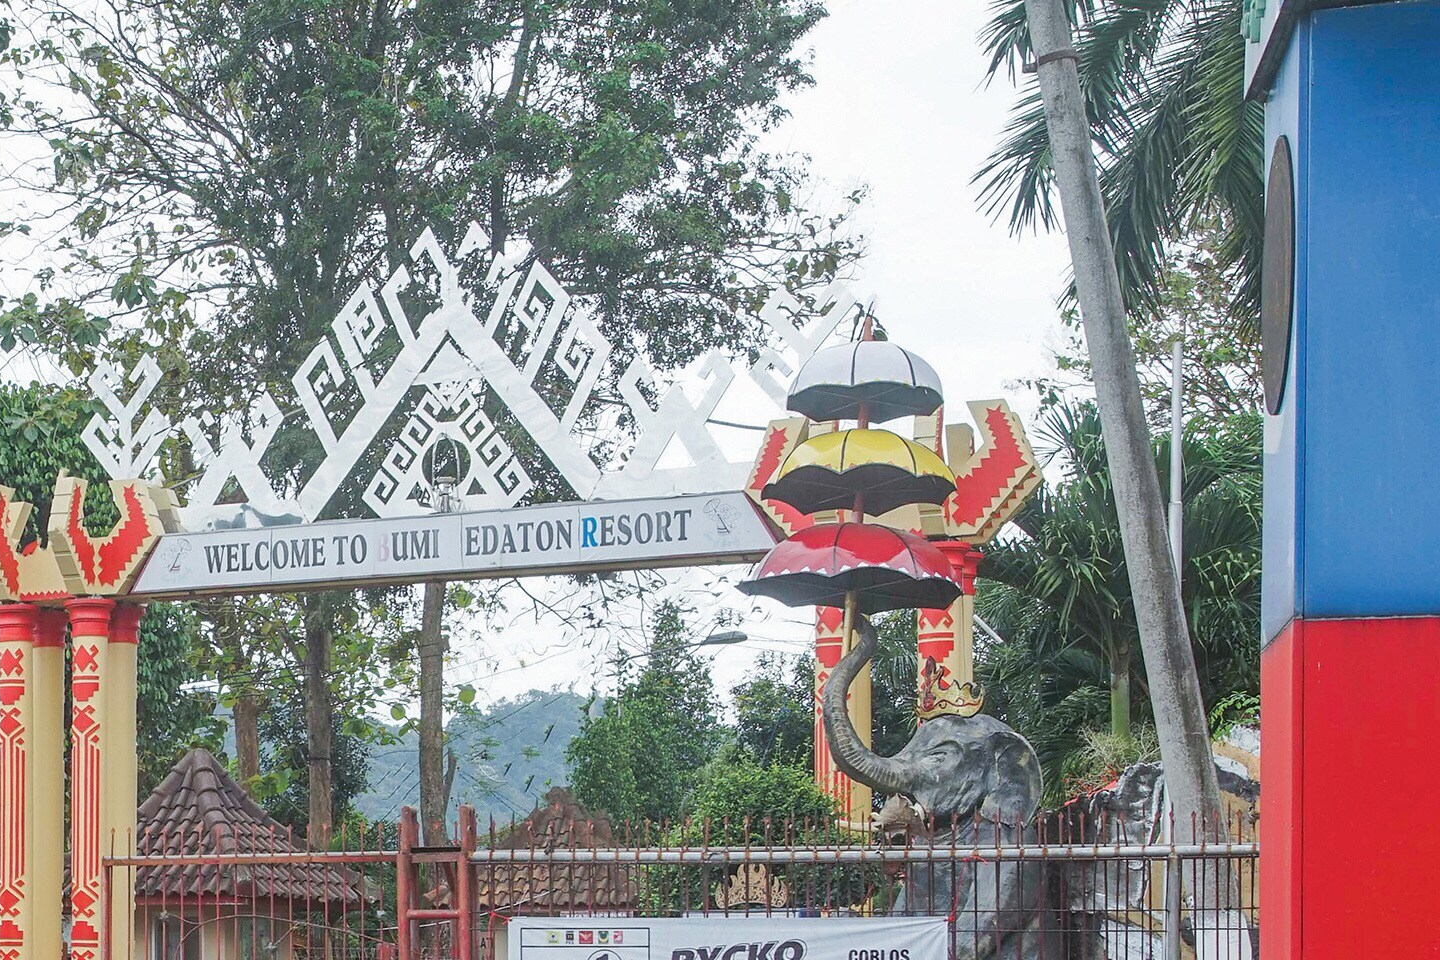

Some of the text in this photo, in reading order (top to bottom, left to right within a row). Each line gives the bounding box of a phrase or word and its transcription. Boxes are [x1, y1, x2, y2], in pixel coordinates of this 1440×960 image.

[204, 537, 326, 574] WELCOME
[332, 533, 368, 566] TO
[581, 509, 692, 548] RESORT
